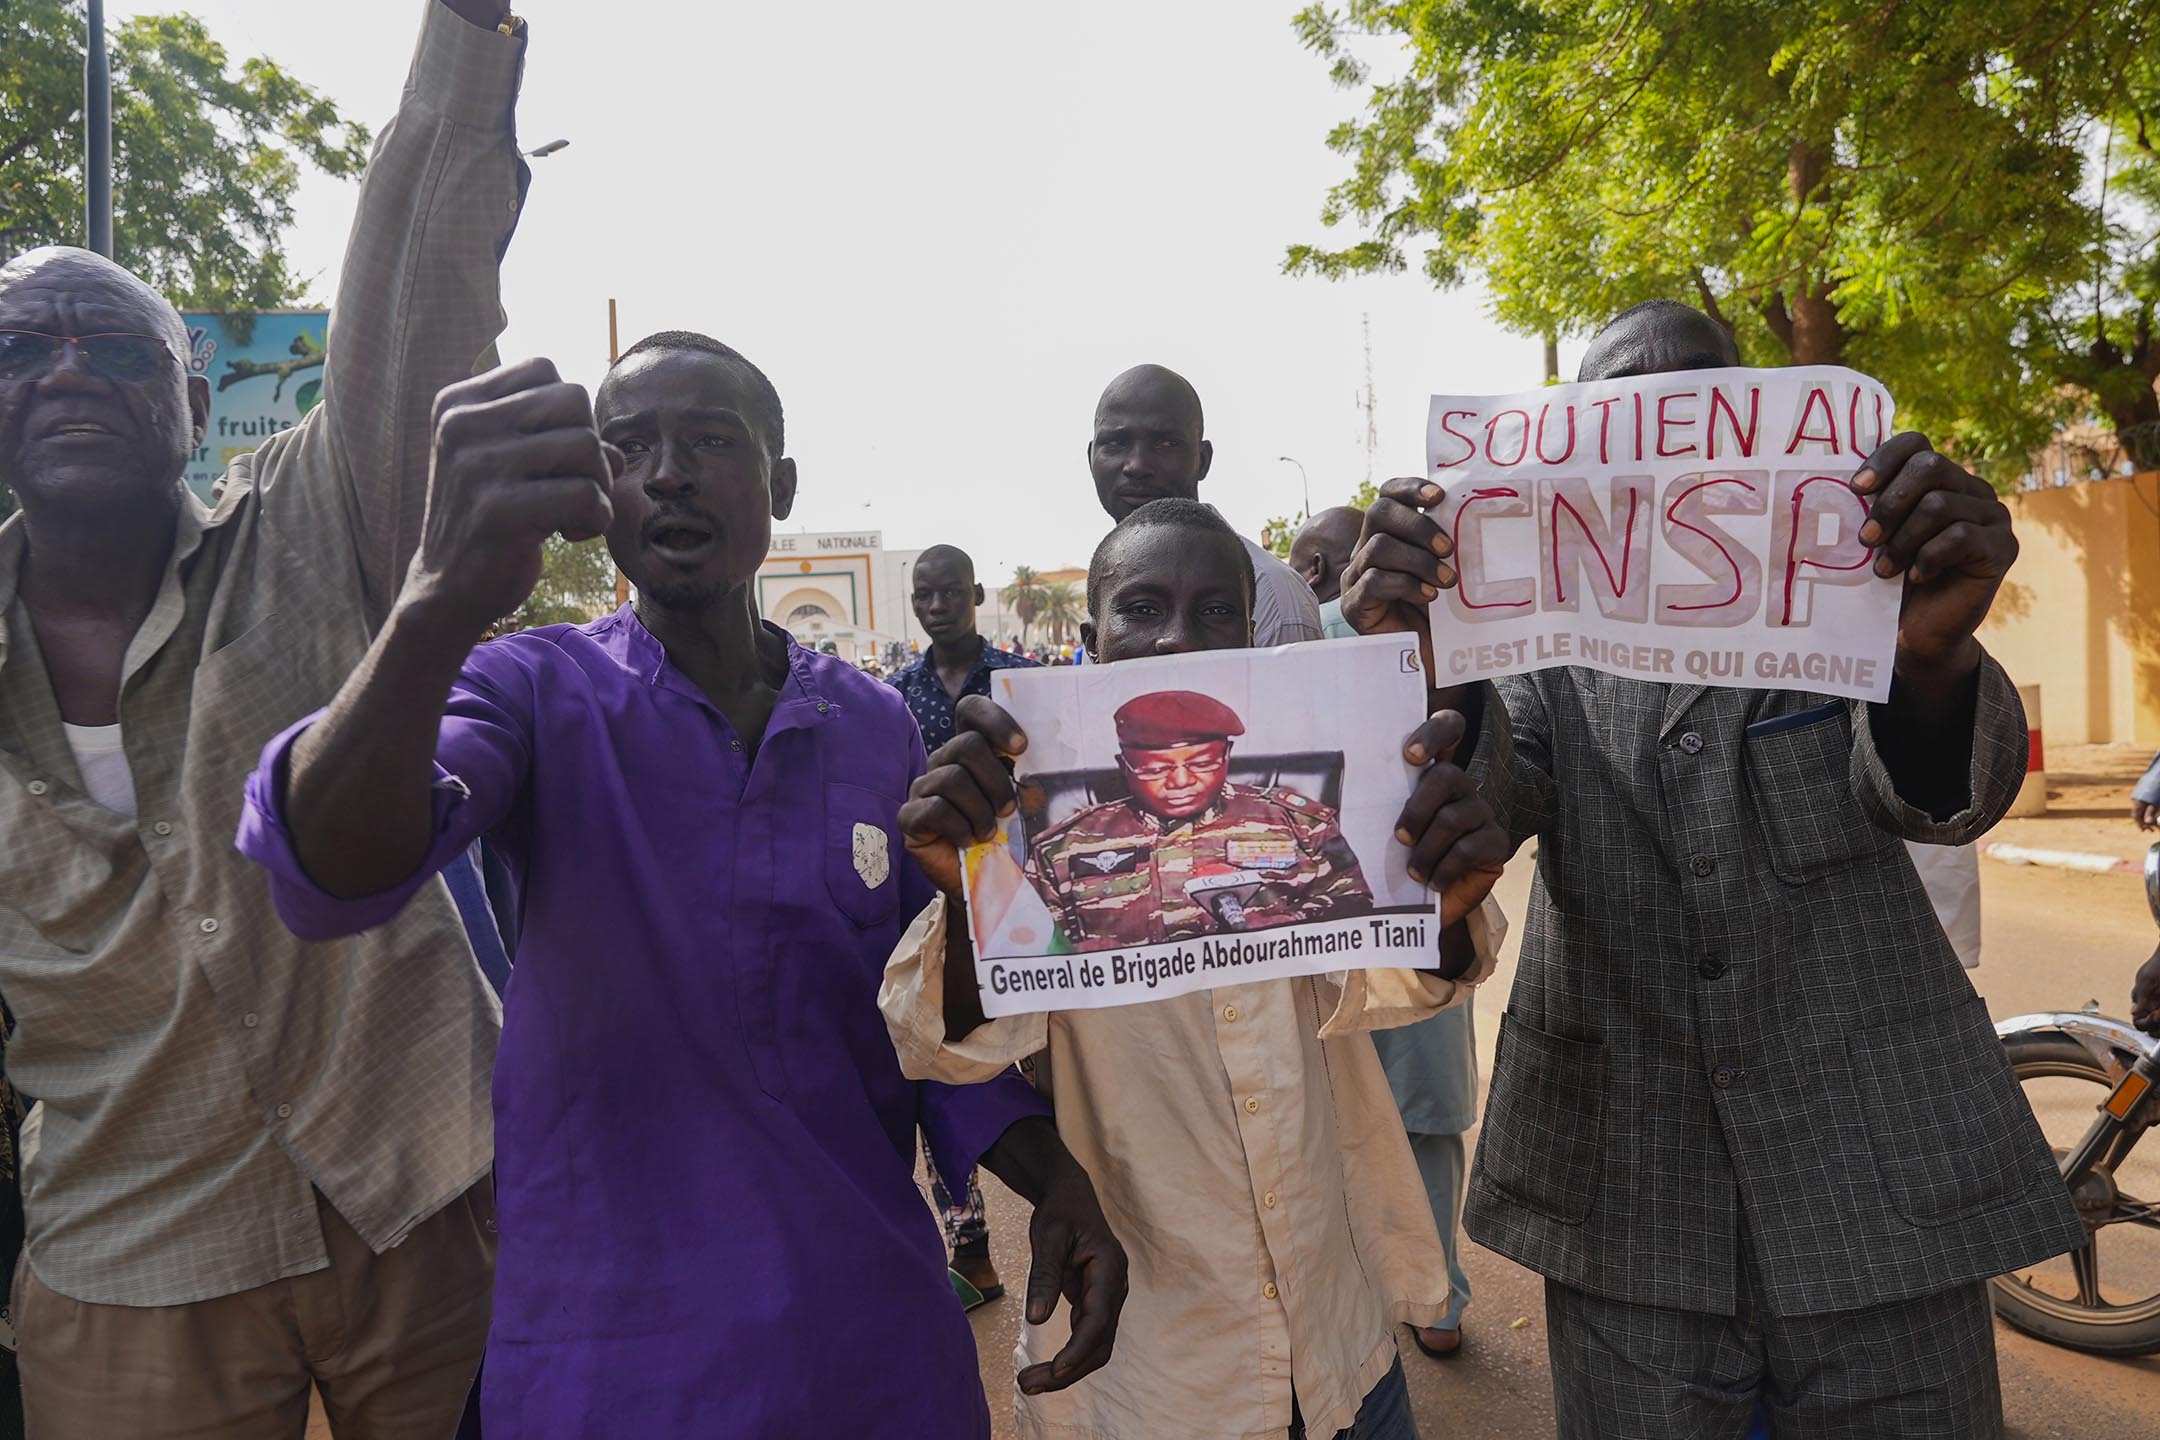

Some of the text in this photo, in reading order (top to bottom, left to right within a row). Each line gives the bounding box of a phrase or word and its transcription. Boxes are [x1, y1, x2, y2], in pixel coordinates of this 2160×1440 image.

[218, 416, 292, 436] fruits
[1437, 386, 1883, 468] SOUTIEN AU
[817, 535, 878, 550] NATIONALE
[1449, 470, 1877, 628] CNSP
[1448, 633, 1877, 689] C'EST LE NIGER QUI GAGNE
[990, 918, 1426, 996] General de Brigade Abdourahmane Tiani
